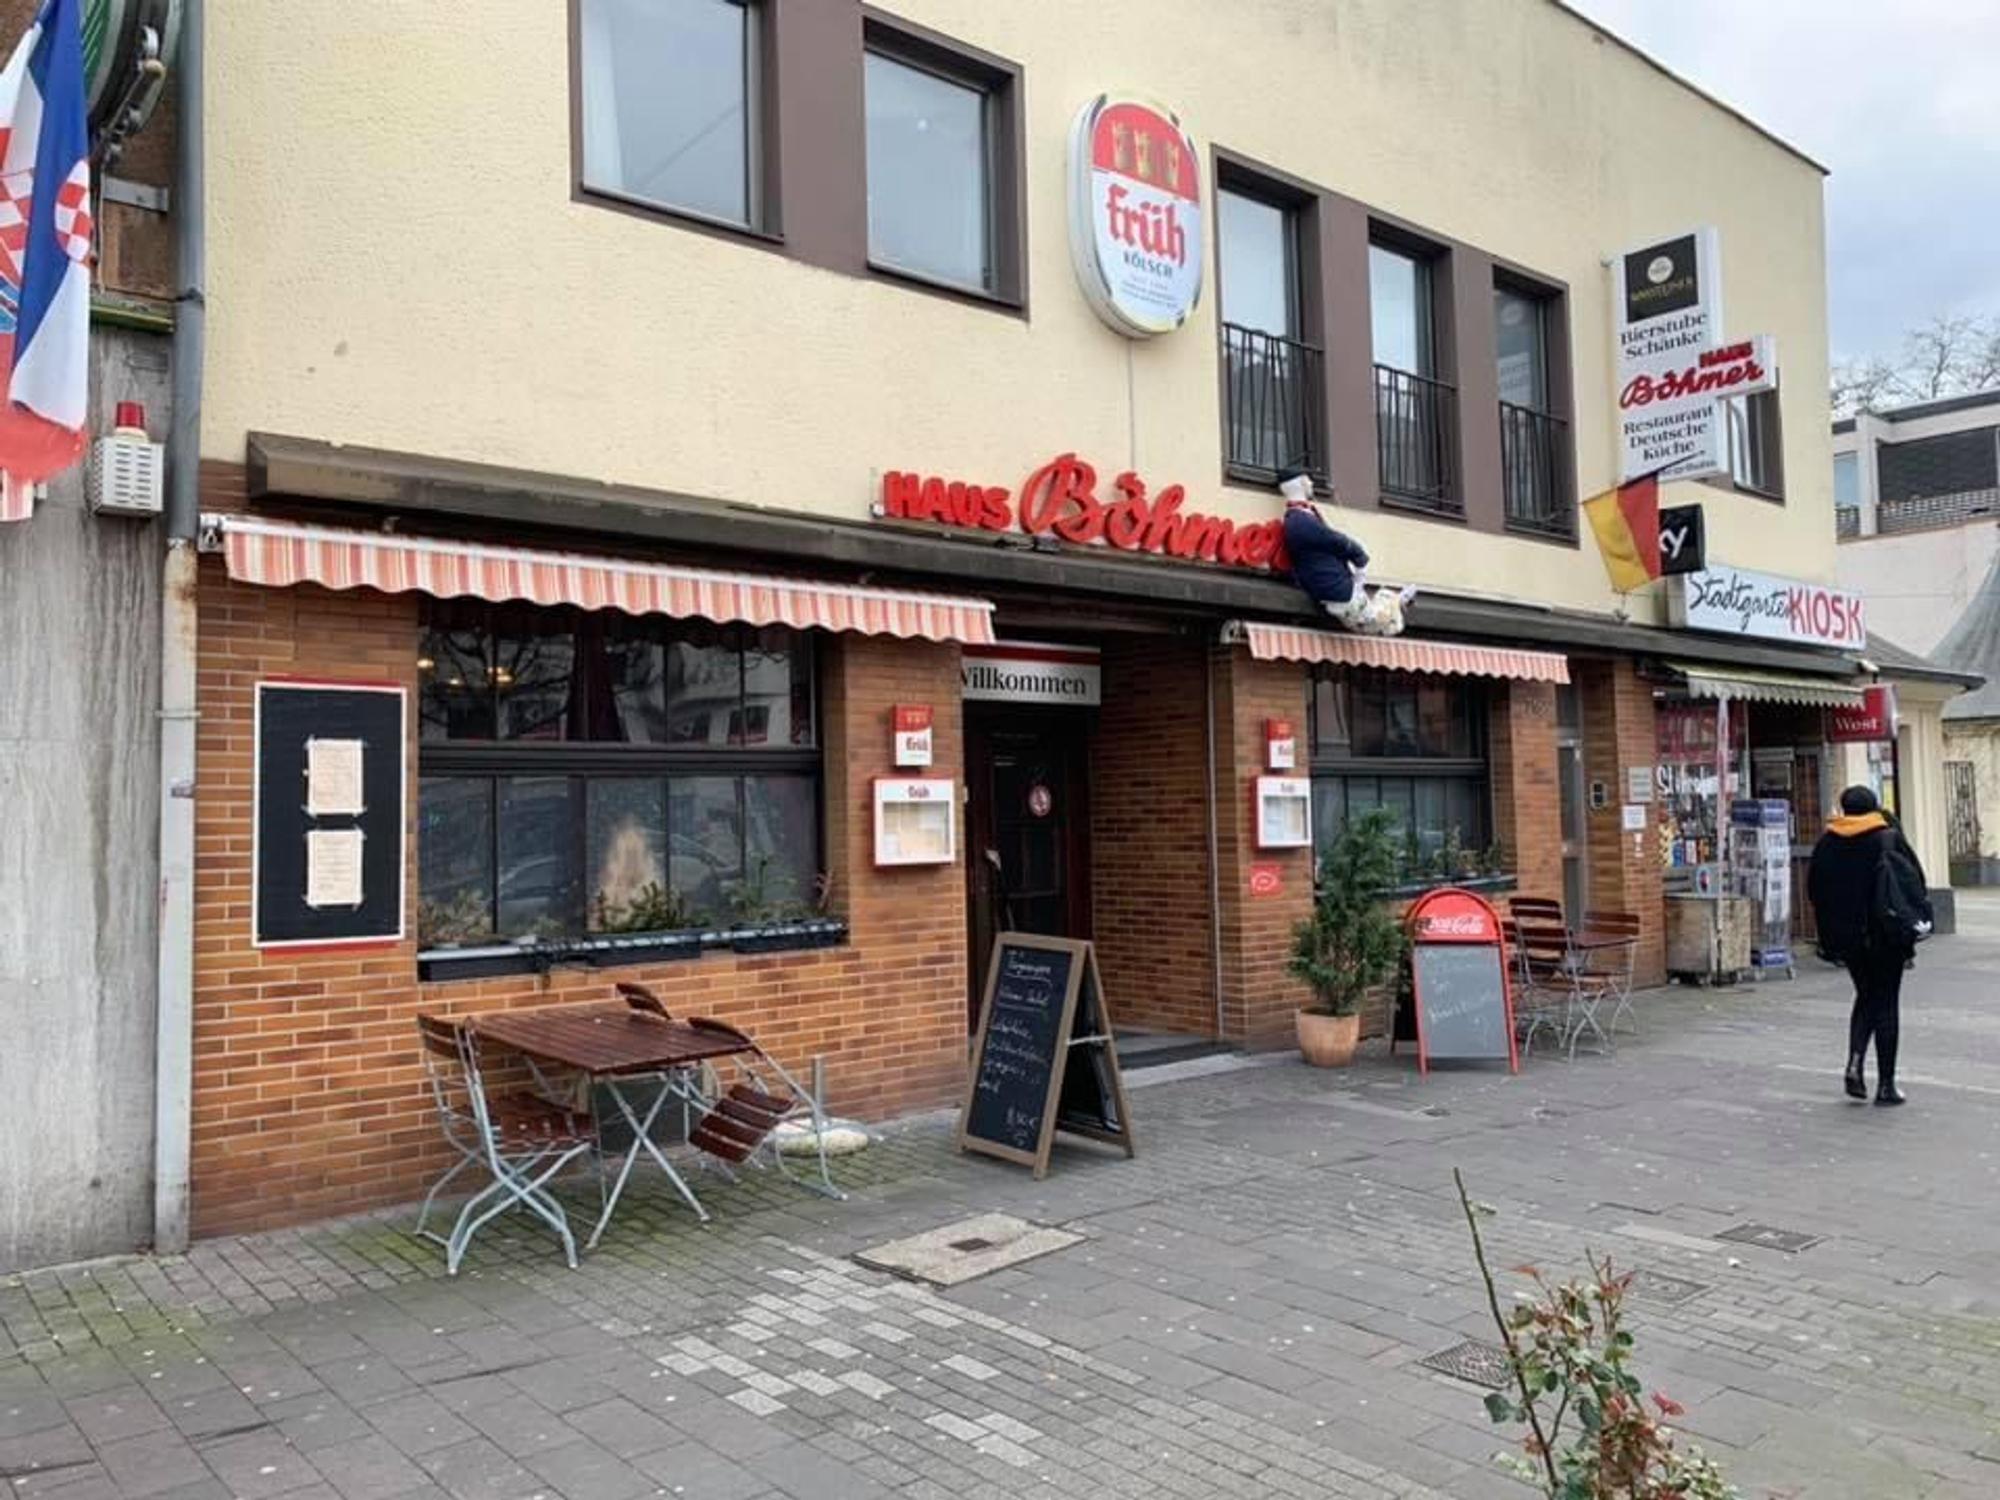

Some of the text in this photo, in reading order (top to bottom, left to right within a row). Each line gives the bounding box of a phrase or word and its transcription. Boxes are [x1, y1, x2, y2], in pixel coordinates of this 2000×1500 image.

[1620, 311, 1708, 346] Bierstube
[1625, 330, 1702, 360] Schänke
[1619, 360, 1764, 409] Böhmer
[1623, 404, 1714, 435] Restaurant
[1629, 422, 1708, 449] Deutsche
[1642, 440, 1696, 461] Küche
[883, 470, 1012, 530] HAUS
[1789, 587, 1862, 641] KIOSK
[1834, 717, 1879, 732] West
